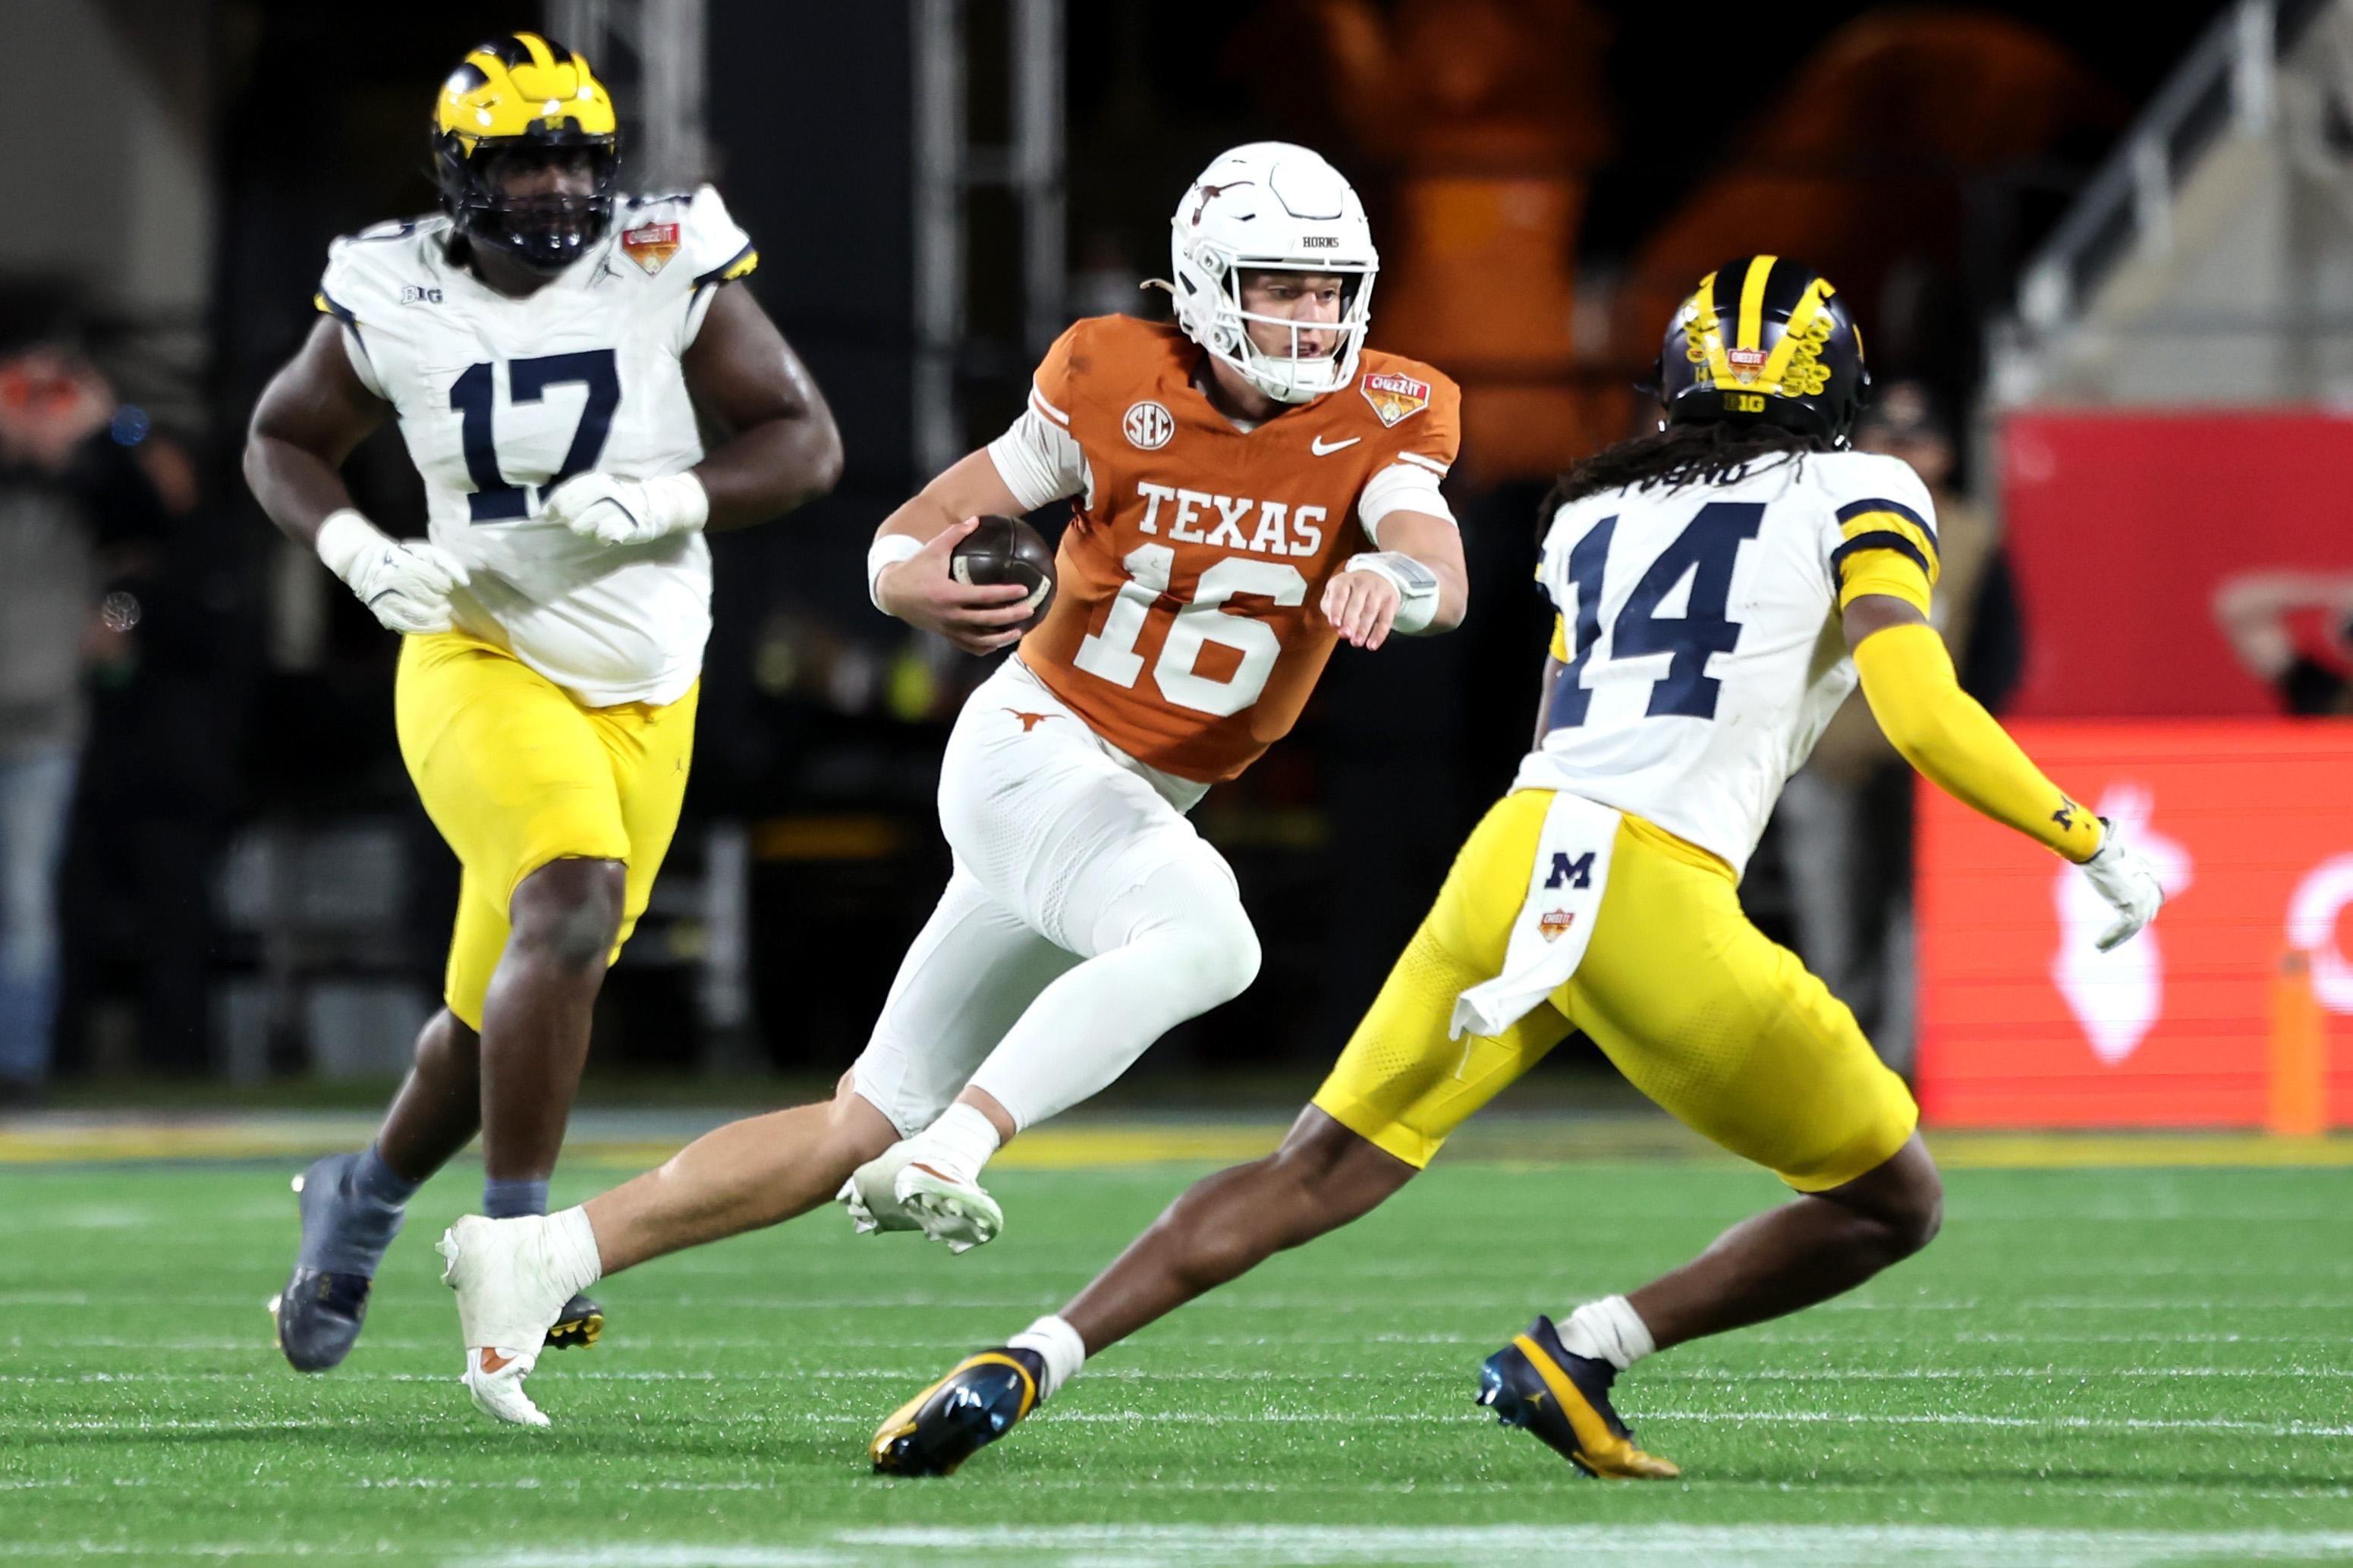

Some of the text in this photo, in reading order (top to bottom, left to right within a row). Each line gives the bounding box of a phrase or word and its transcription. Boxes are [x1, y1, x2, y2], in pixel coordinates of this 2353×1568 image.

[1302, 236, 1340, 248] HORNS
[450, 348, 621, 521] 17
[1128, 404, 1169, 447] SEC
[1137, 481, 1328, 558] TEXAS
[1073, 542, 1308, 718] 16
[1549, 501, 1767, 729] 14
[1543, 851, 1596, 889] M
